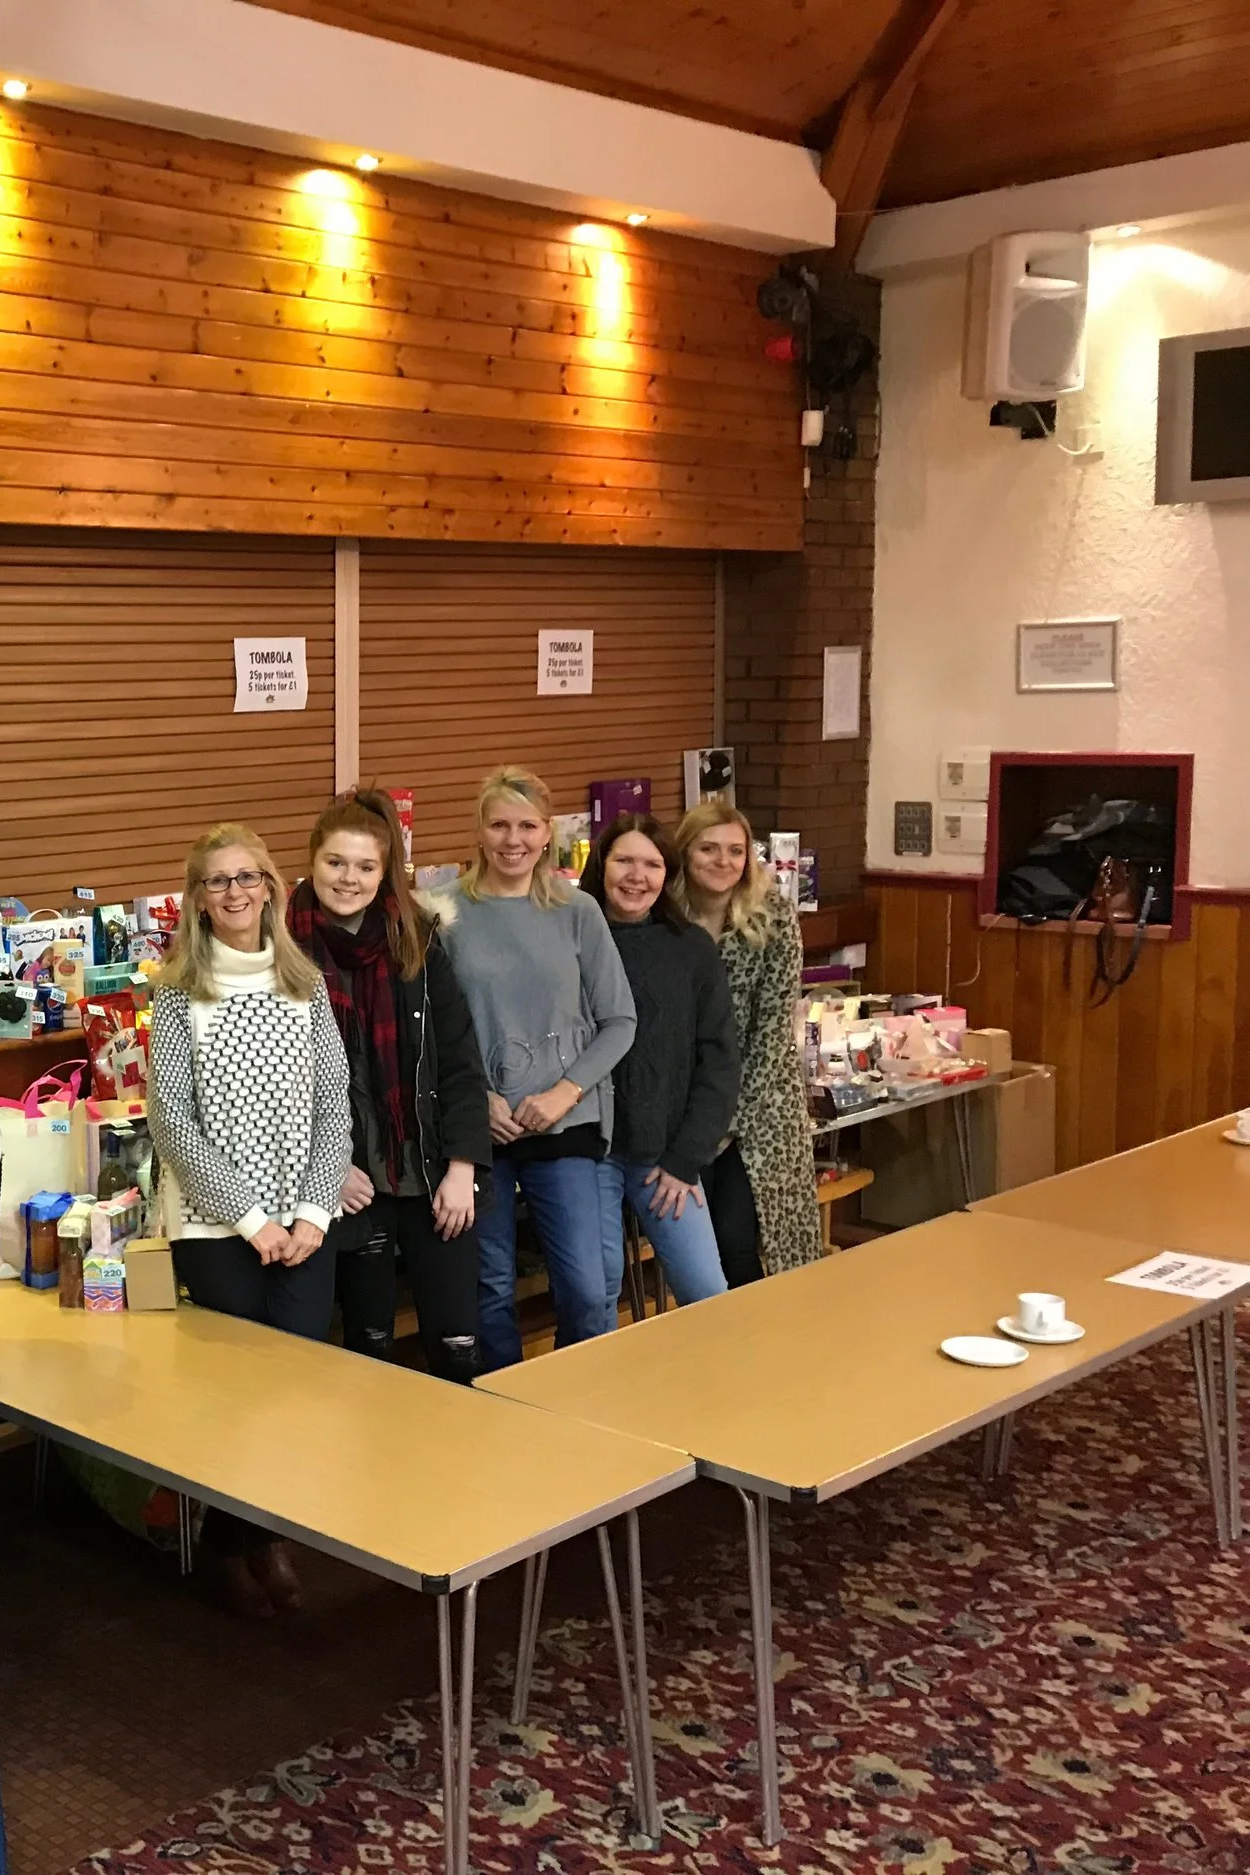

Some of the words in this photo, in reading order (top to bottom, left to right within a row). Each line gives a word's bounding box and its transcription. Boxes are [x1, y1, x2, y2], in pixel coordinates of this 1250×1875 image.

[549, 641, 583, 653] TOMBOLA
[249, 651, 293, 664] TOMBOLA
[249, 670, 262, 682] 25p
[264, 671, 274, 682] per
[248, 681, 253, 692] 5
[254, 682, 277, 692] tickets
[277, 682, 287, 691] for
[288, 681, 297, 690] £1
[68, 951, 84, 959] 325
[52, 992, 65, 1001] 320
[51, 1124, 67, 1132] 200
[103, 1269, 122, 1277] 220
